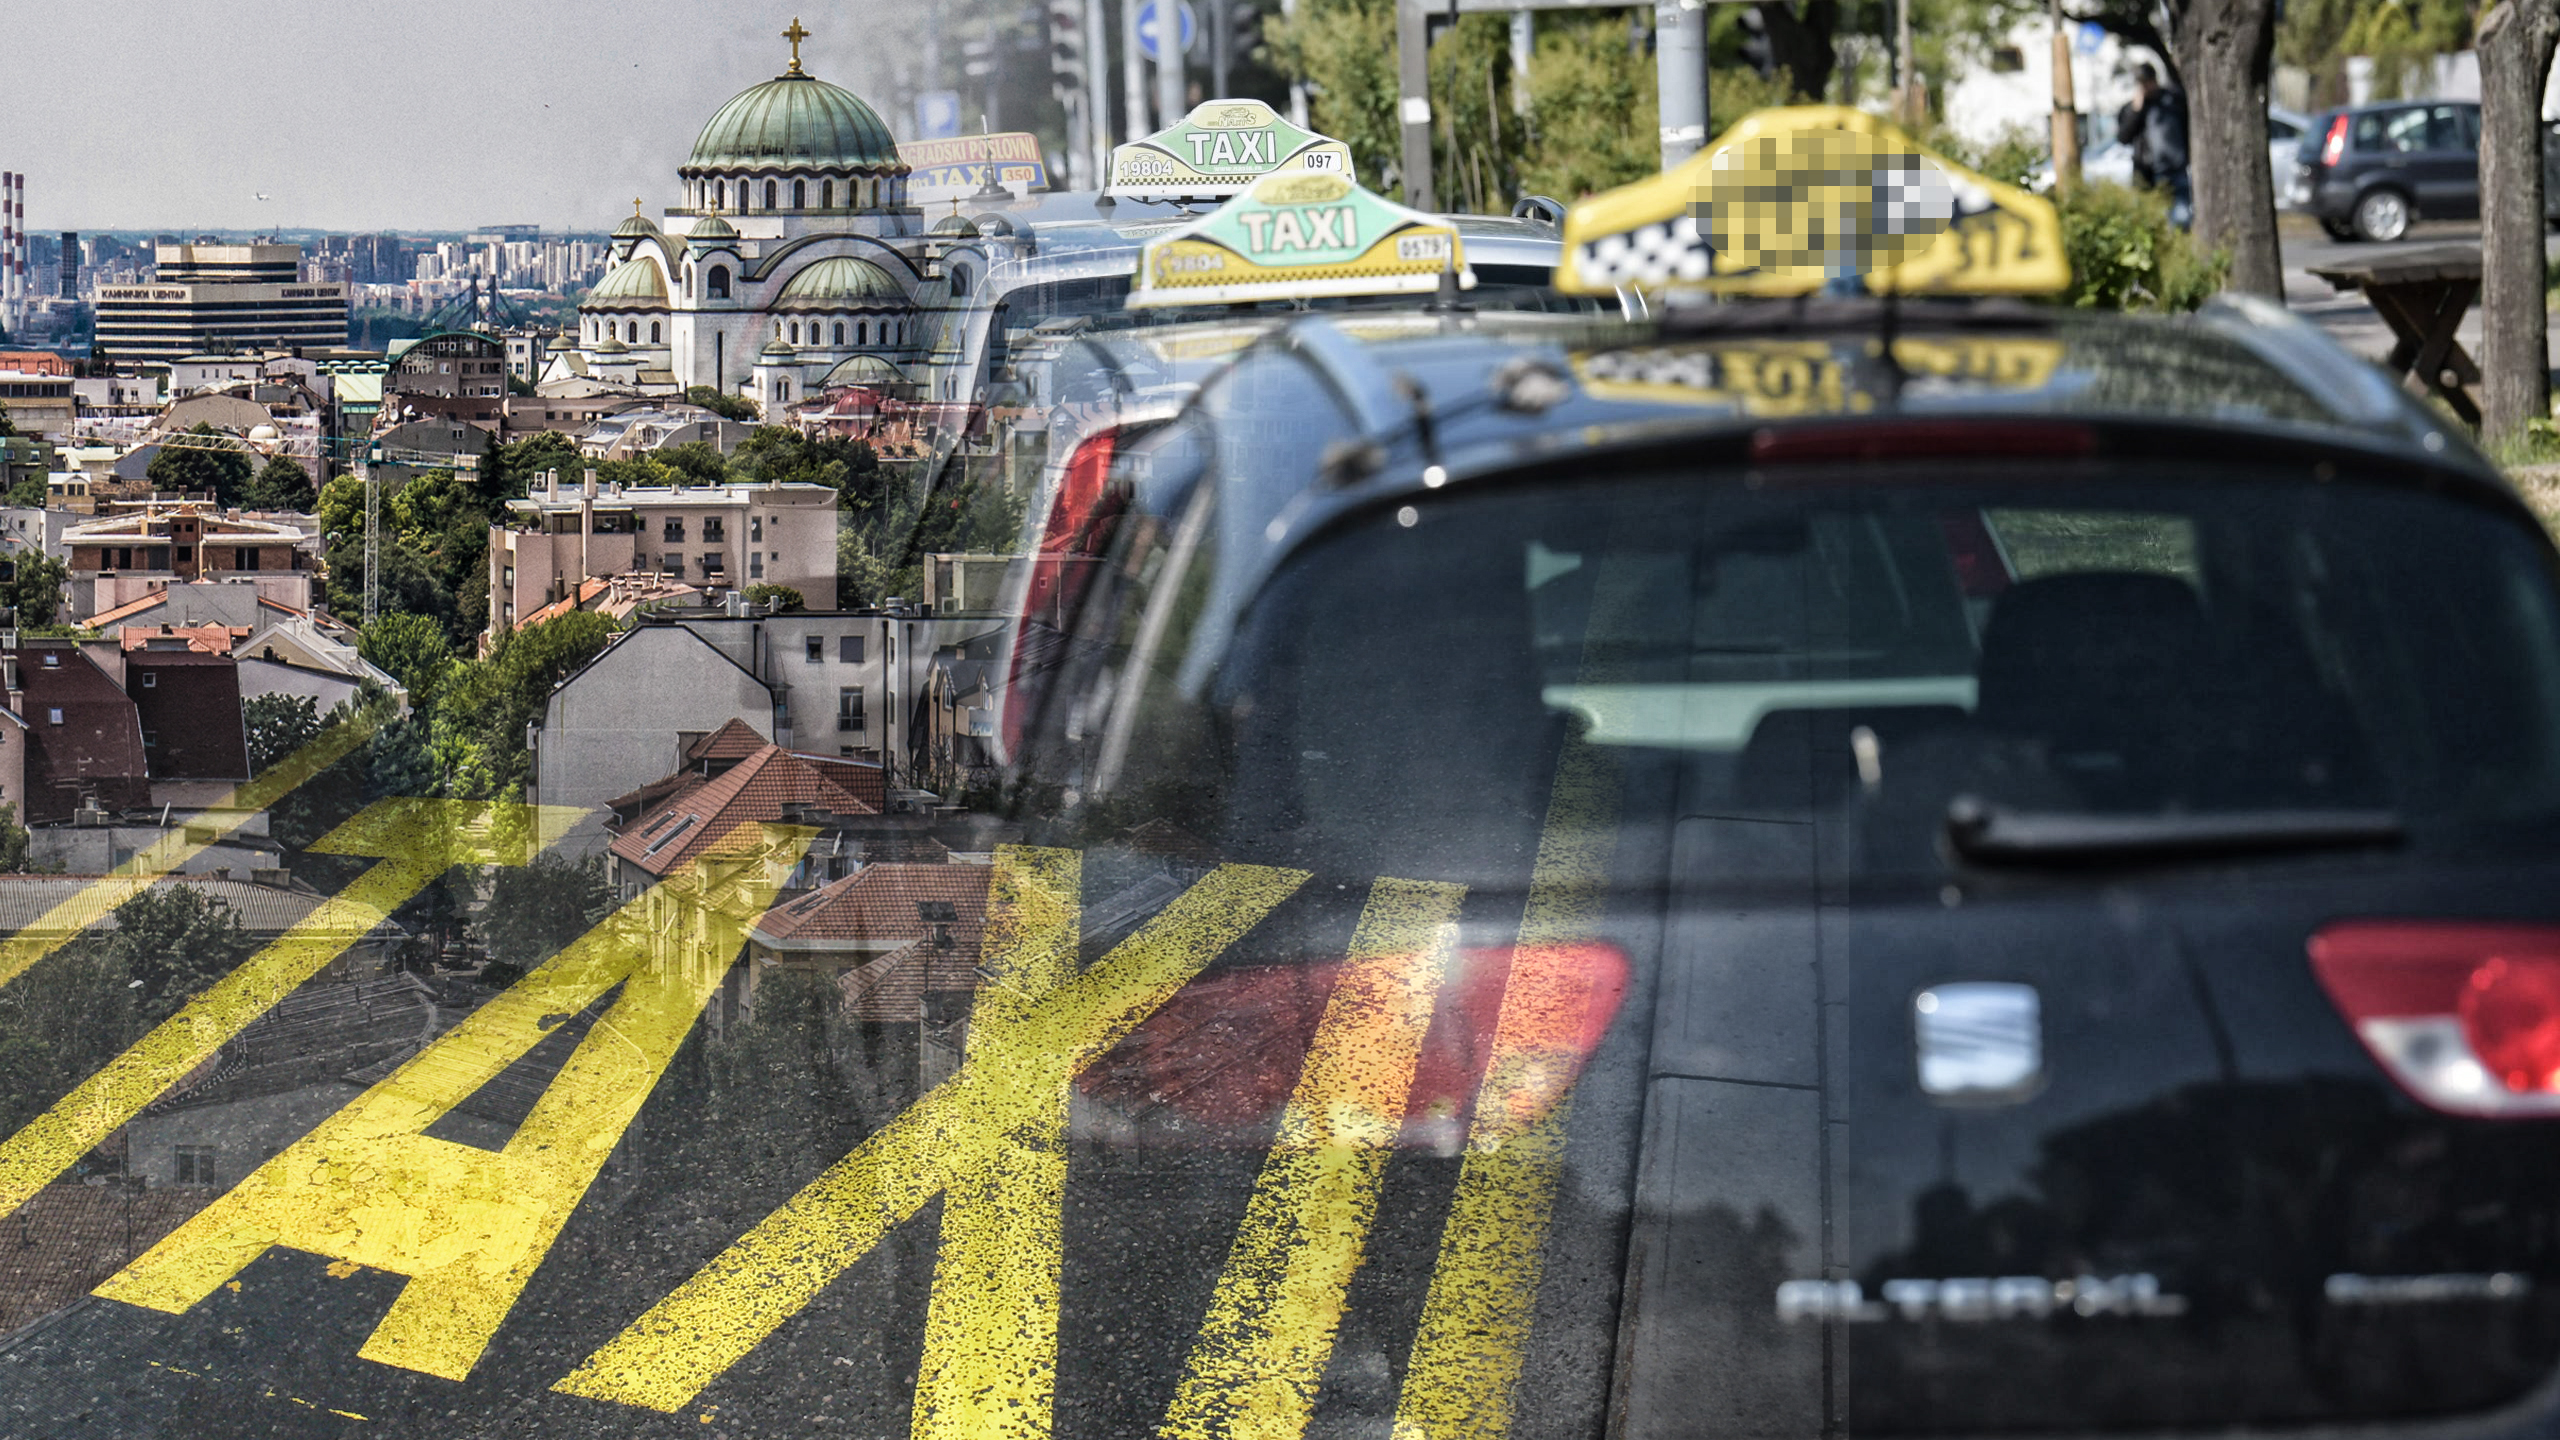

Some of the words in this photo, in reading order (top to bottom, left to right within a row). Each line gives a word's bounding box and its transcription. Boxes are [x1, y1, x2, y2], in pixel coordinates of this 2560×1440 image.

[968, 135, 1038, 161] POSLOVNI
[1185, 130, 1277, 166] TAXI
[1005, 168, 1033, 181] 350
[1119, 159, 1174, 178] 19804
[1307, 154, 1332, 169] 097
[1240, 206, 1359, 254] TAXI
[0, 797, 1468, 1440] TAXI
